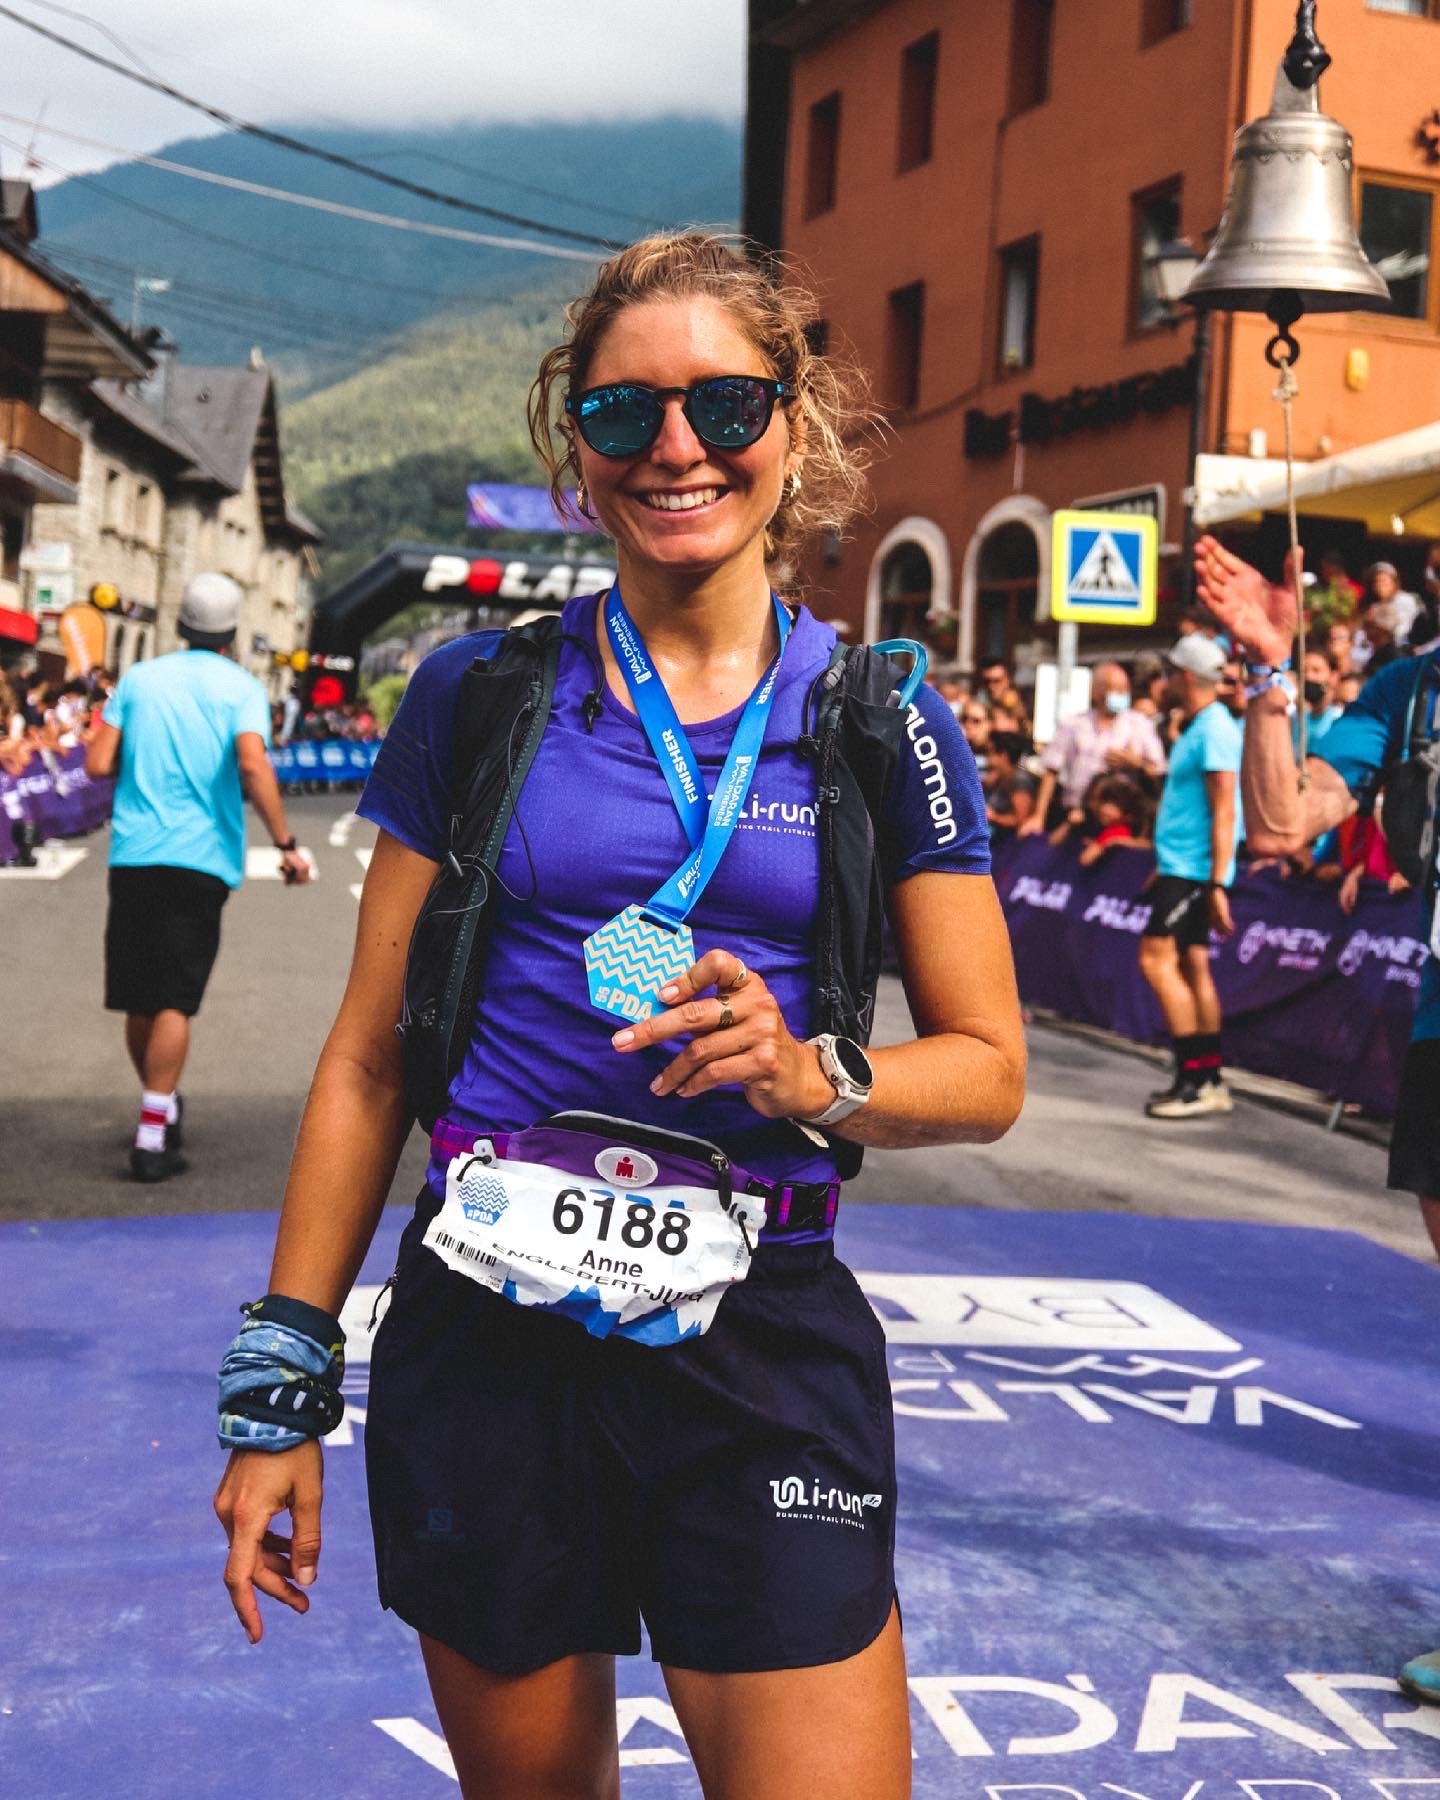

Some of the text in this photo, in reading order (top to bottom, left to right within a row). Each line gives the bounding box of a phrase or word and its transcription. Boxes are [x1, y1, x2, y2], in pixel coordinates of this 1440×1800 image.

[661, 728, 699, 805] FINISHER
[752, 793, 816, 826] i-run
[757, 825, 781, 833] TRAIL
[783, 828, 816, 837] FITNESS
[552, 1188, 692, 1257] 6188
[579, 1249, 643, 1278] Anne
[812, 1478, 863, 1518] i-run
[776, 1511, 865, 1531] RUNNING TRAIL FITNESS
